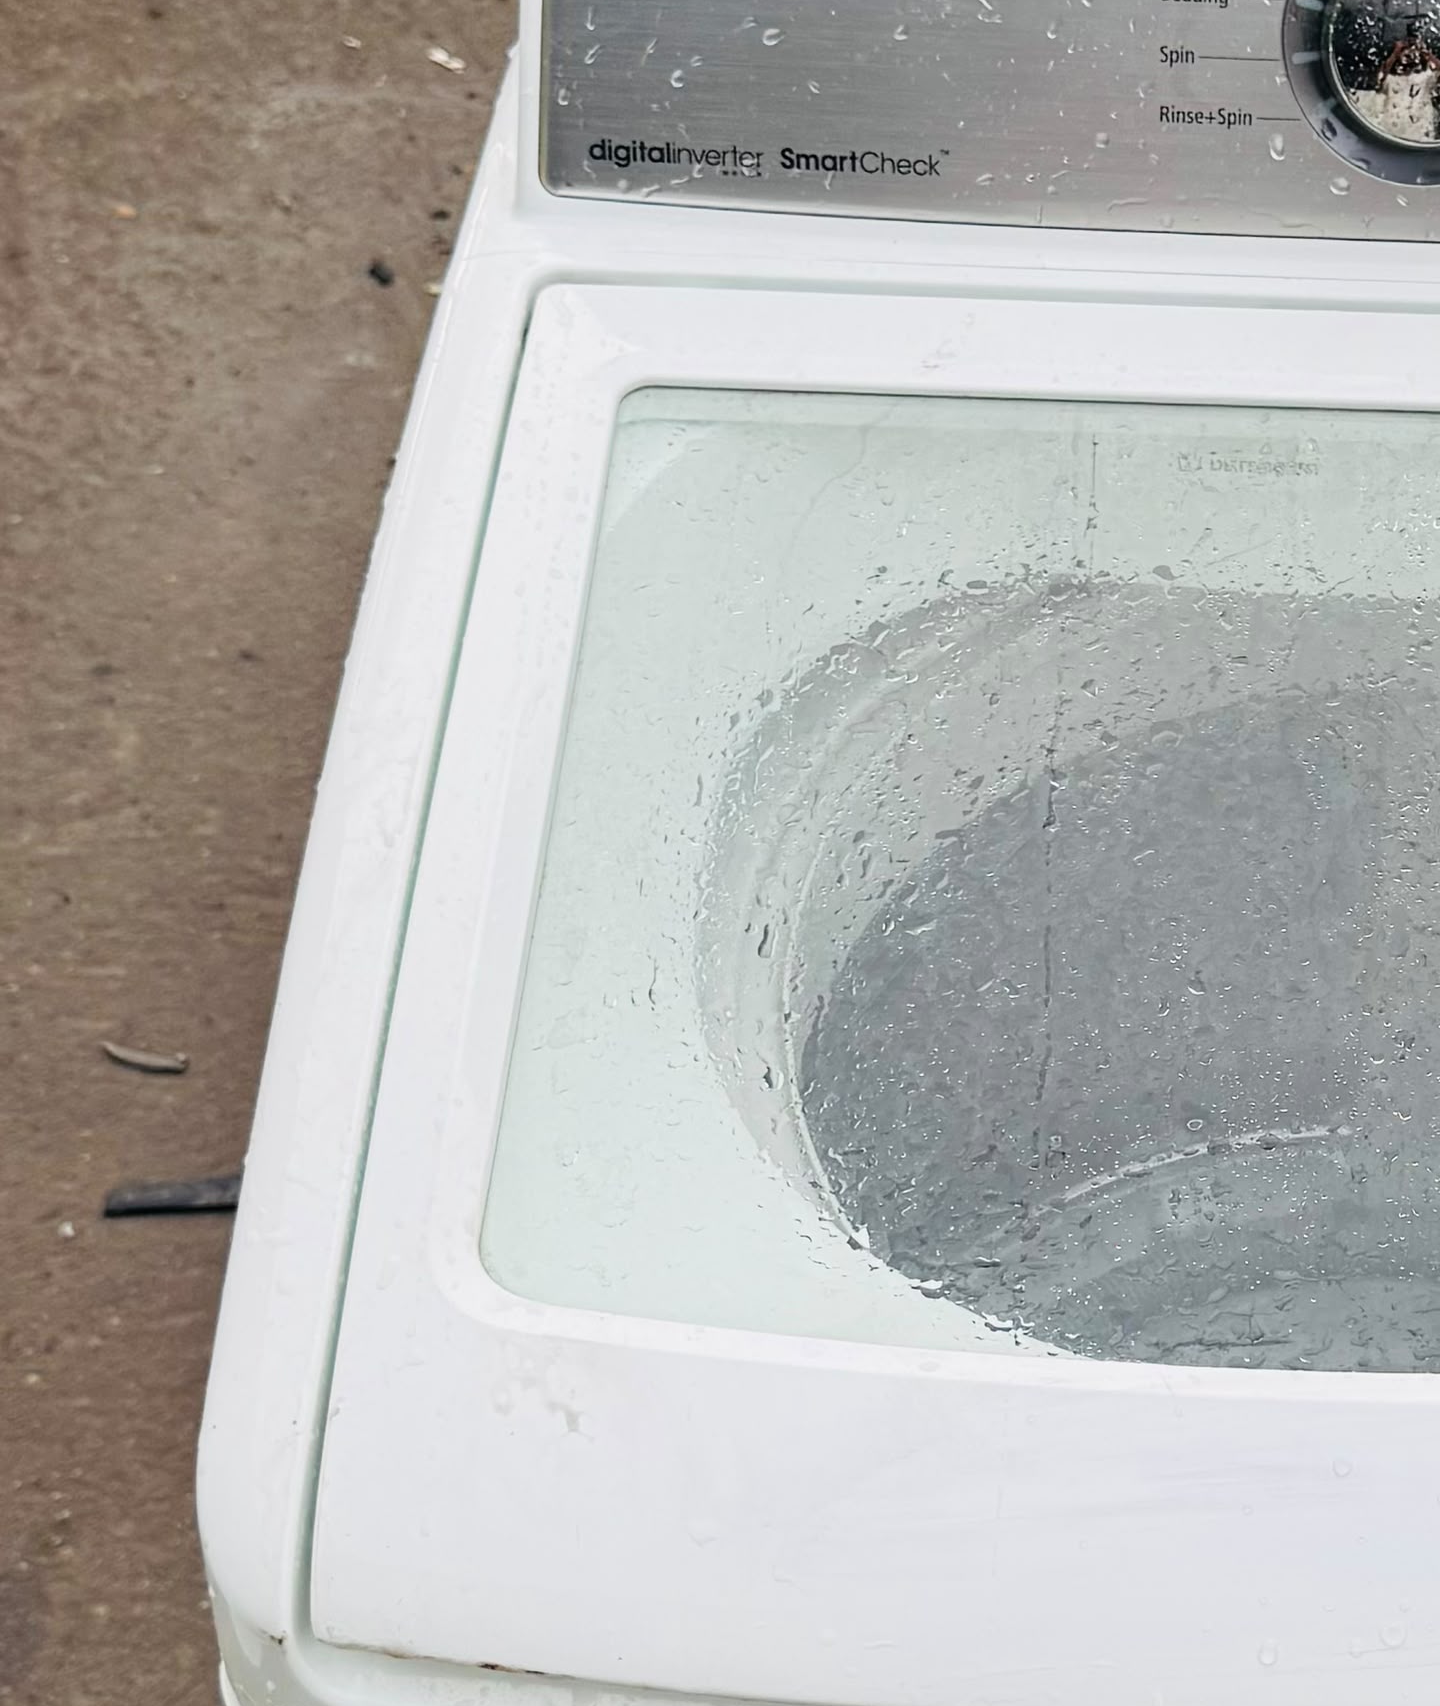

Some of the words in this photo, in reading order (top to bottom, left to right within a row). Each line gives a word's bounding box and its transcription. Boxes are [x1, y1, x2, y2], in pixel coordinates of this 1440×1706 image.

[1160, 45, 1195, 68] Spin
[1159, 105, 1253, 132] Rinse+Spin
[588, 139, 765, 168] digitalinverter
